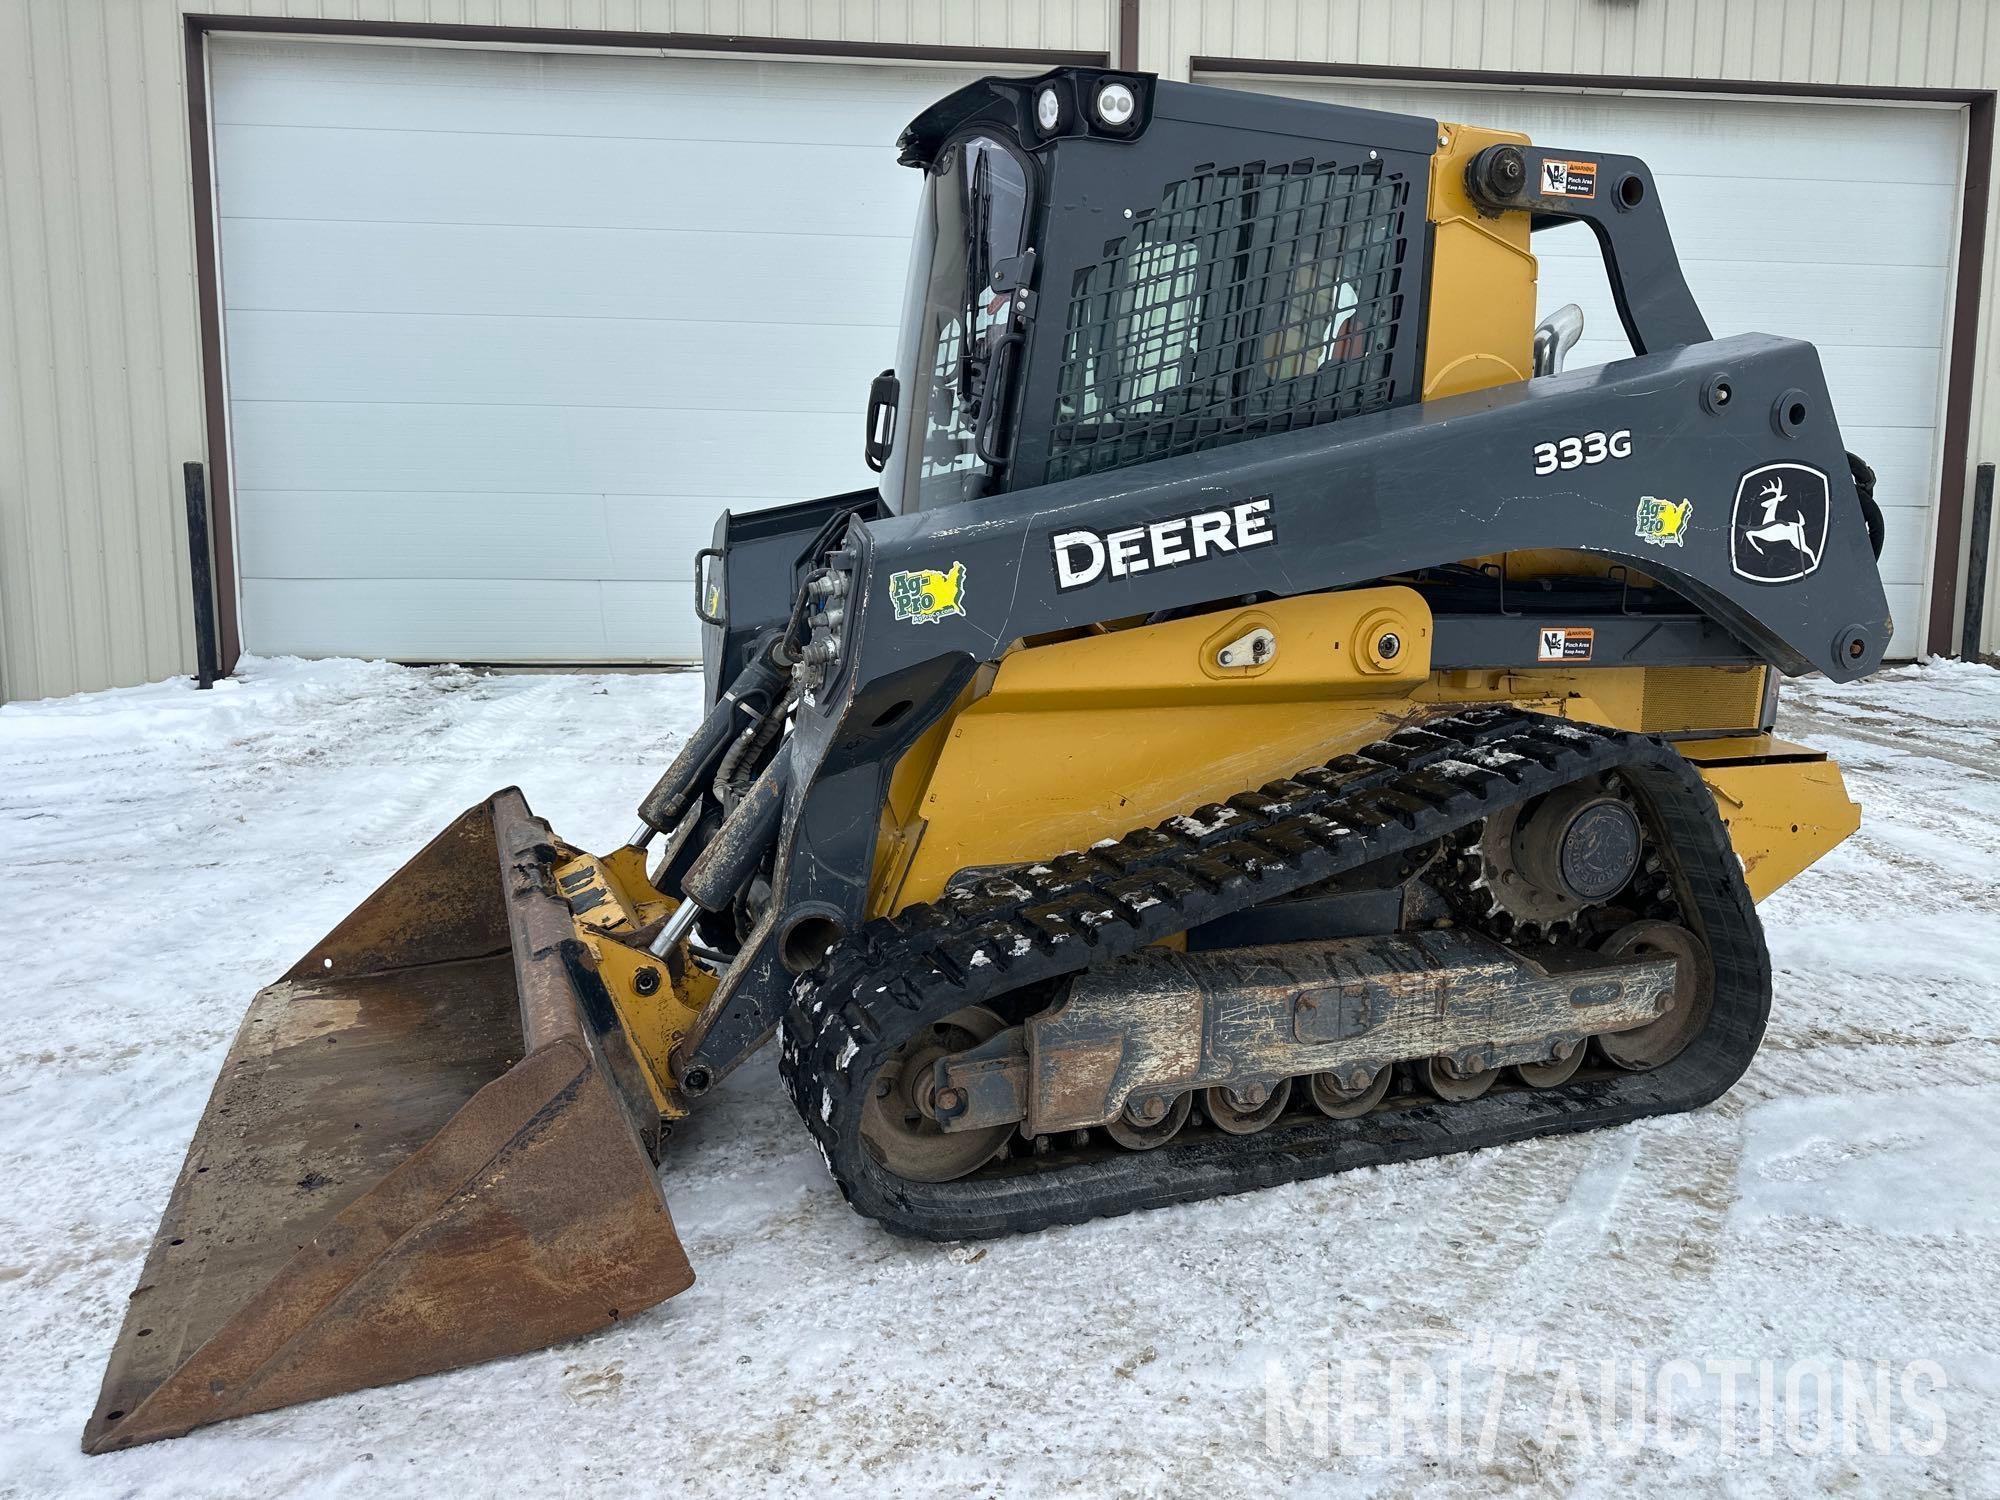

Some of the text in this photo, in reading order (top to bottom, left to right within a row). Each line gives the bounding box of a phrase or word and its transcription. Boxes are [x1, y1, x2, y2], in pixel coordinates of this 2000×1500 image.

[1533, 430, 1632, 475] 333G
[1640, 499, 1666, 519] Ag-
[1639, 516, 1664, 532] Pro
[1053, 499, 1274, 589] DEERE
[894, 574, 929, 598] Ag-
[896, 593, 934, 616] Pro
